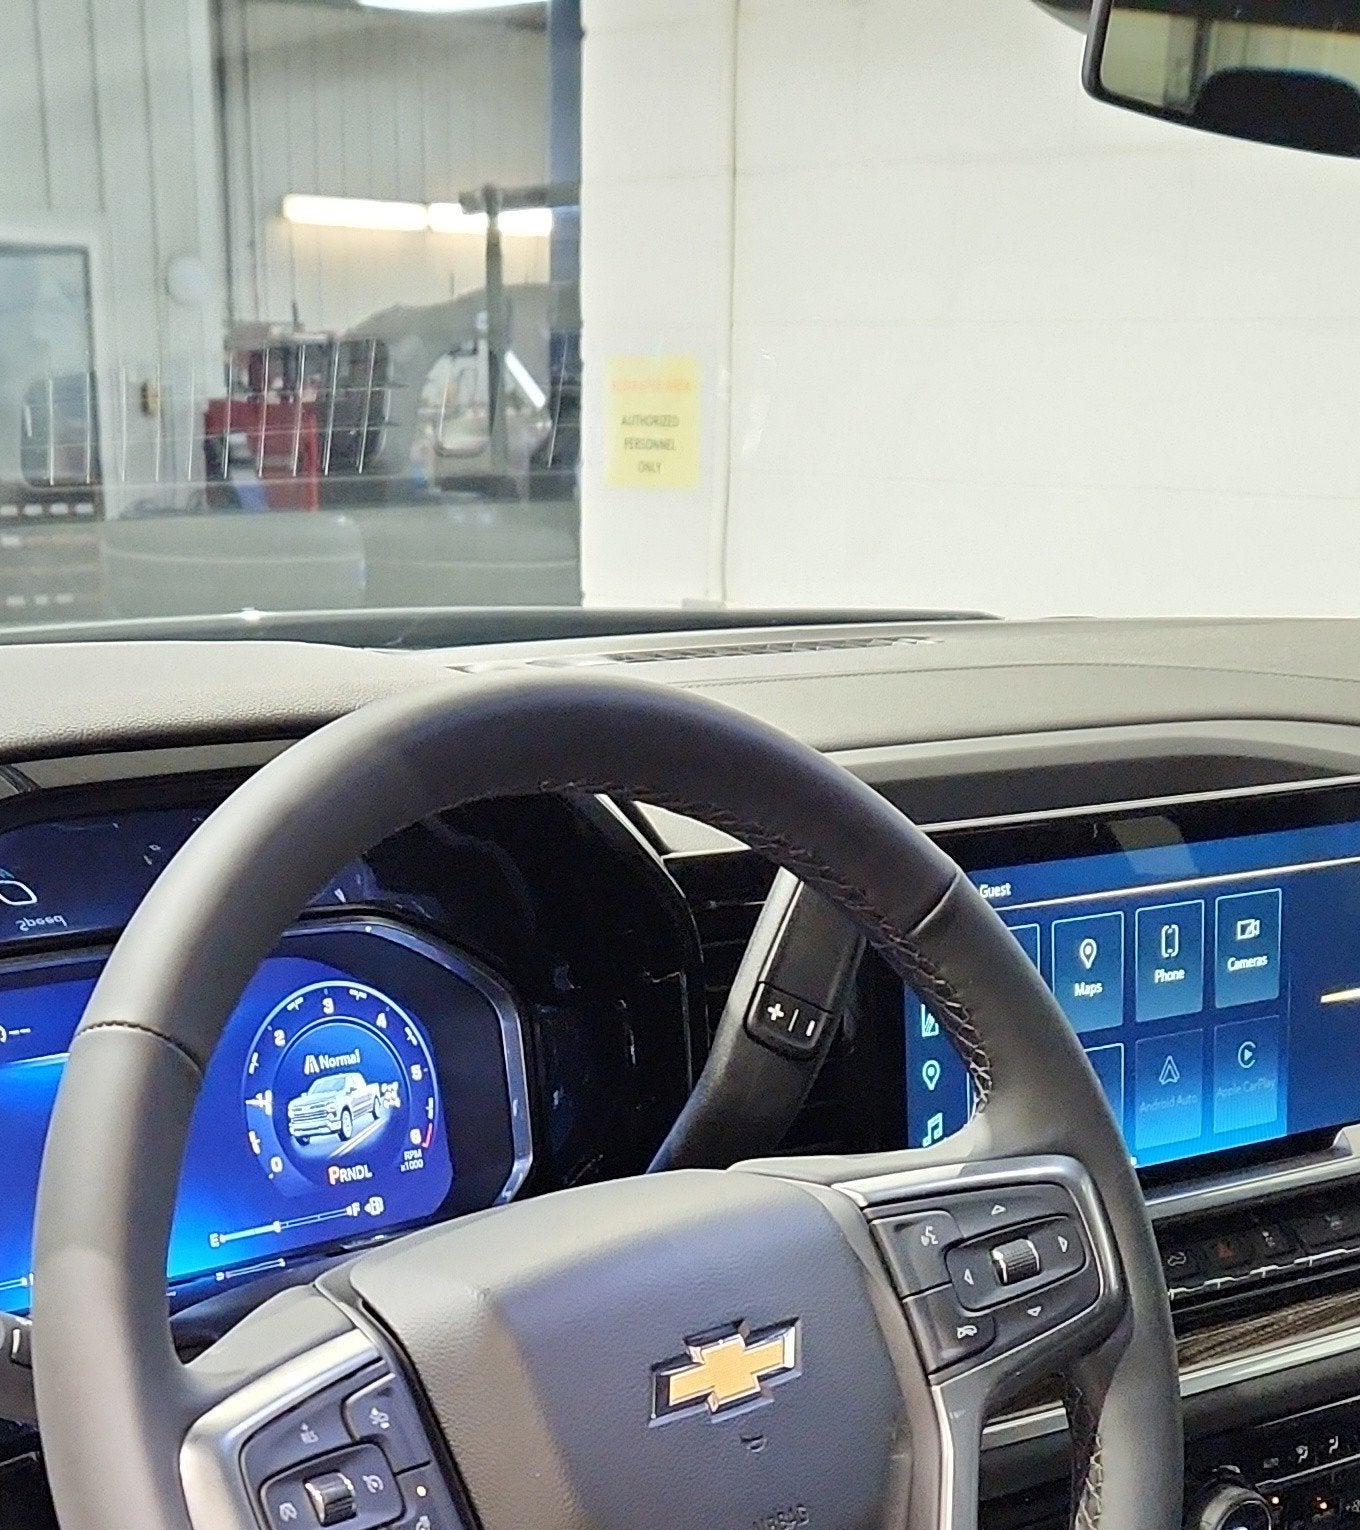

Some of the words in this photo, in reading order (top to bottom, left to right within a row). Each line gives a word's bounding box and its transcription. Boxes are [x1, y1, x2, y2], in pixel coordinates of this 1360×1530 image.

[980, 882, 1011, 899] Guest
[1226, 954, 1269, 972] Cameras
[1154, 968, 1185, 983] Phone
[1074, 981, 1103, 998] Maps
[321, 997, 335, 1015] 3
[375, 1012, 388, 1029] 4
[273, 1029, 287, 1047] 2
[318, 1048, 361, 1070] Normal
[411, 1064, 423, 1081] 5
[403, 1148, 423, 1161] RPM
[328, 1164, 373, 1184] PRNDL
